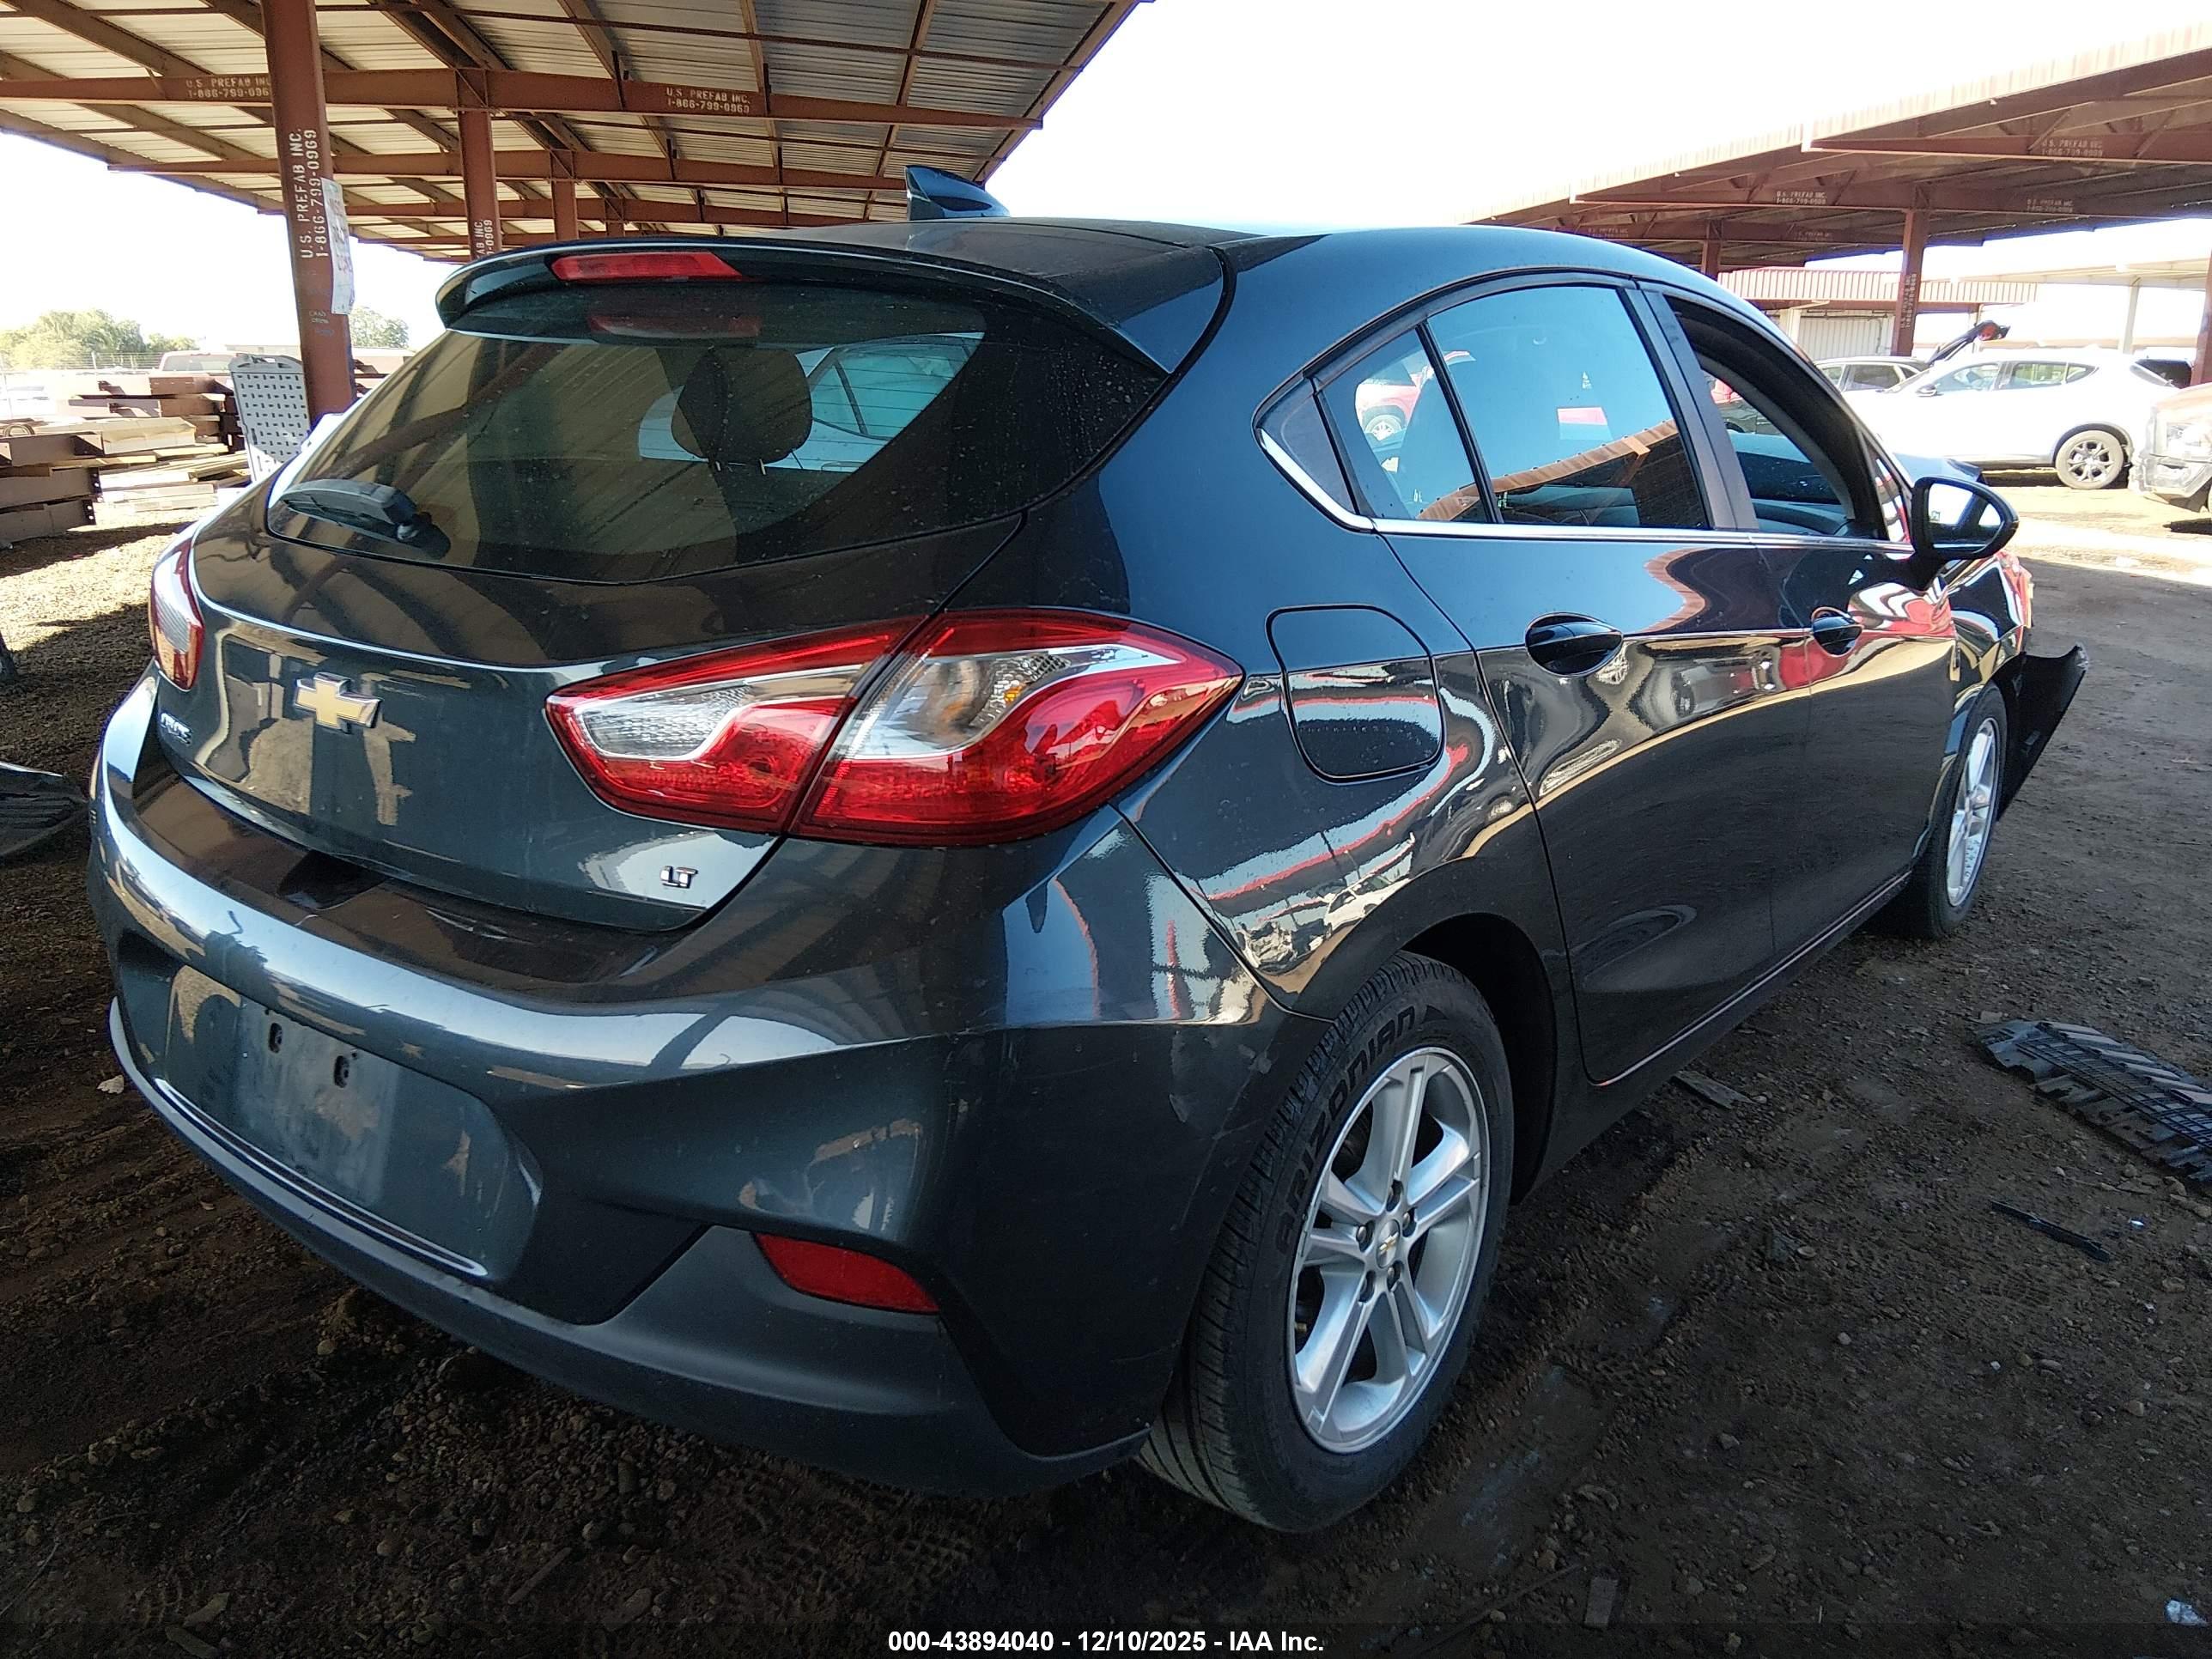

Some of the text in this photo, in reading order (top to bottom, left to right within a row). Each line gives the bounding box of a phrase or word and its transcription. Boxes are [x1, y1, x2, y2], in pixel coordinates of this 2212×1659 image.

[211, 77, 251, 88] PREFAB
[188, 87, 270, 99] 1-866-799-096
[690, 88, 728, 102] PREFAB
[289, 128, 314, 258] U.S. PREFAB INC.
[303, 129, 330, 258] 1-866-799-0969
[660, 865, 698, 889] LT
